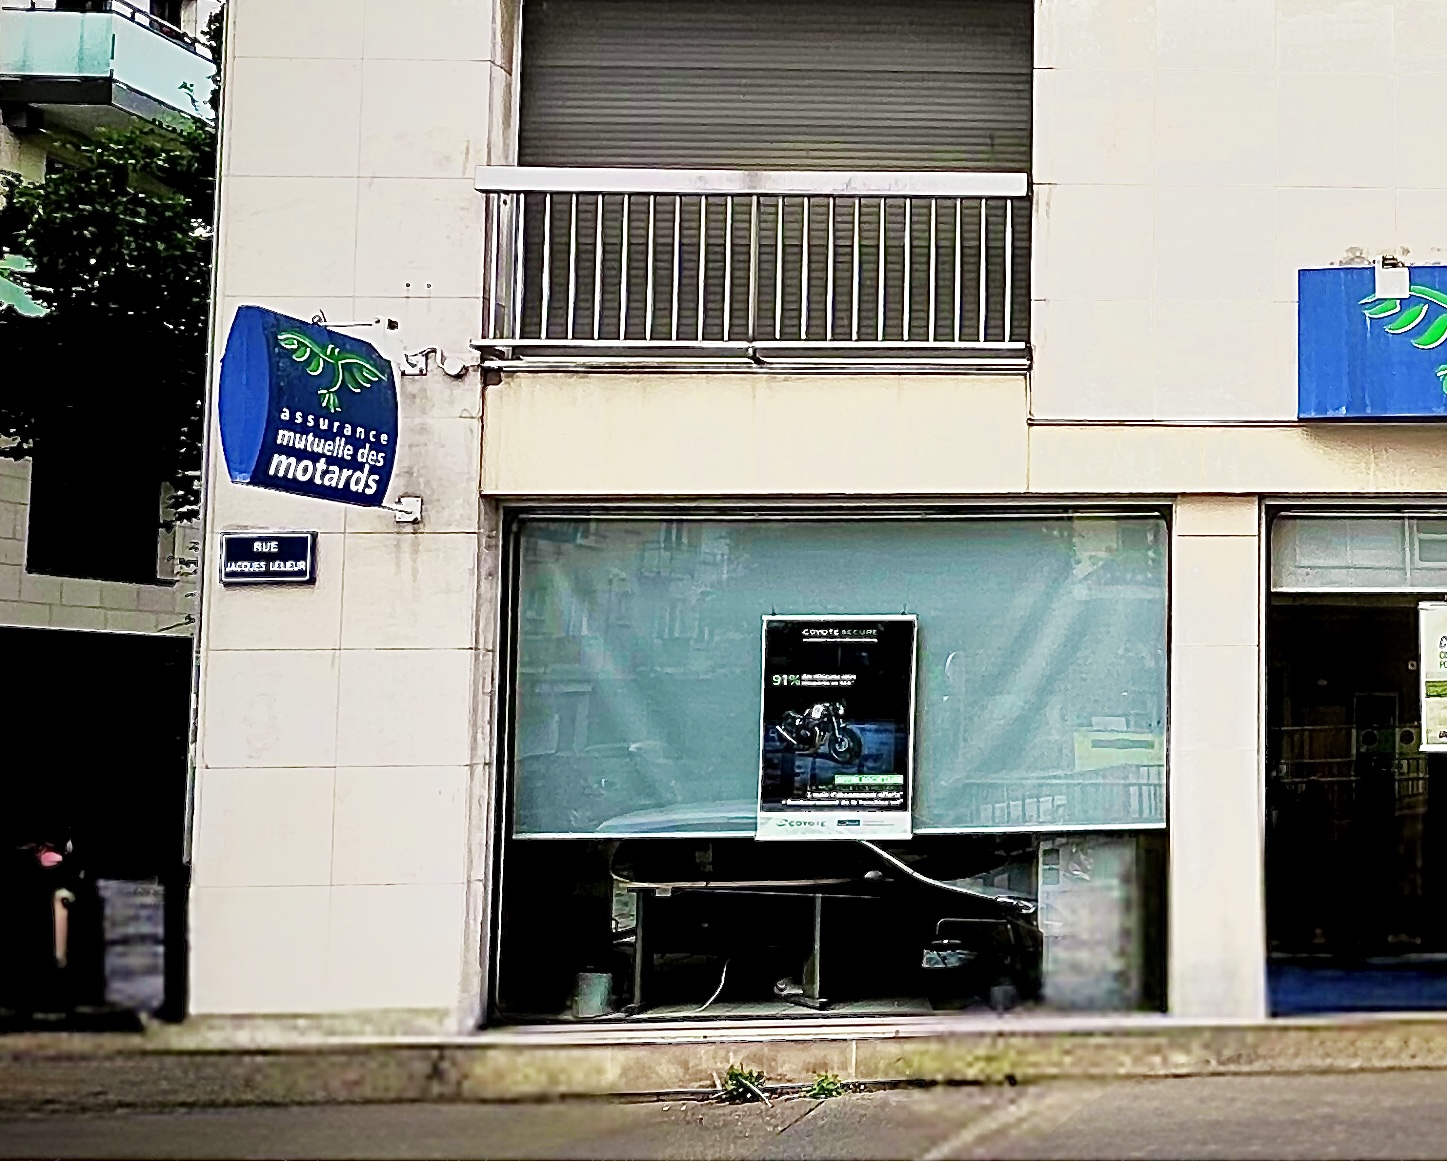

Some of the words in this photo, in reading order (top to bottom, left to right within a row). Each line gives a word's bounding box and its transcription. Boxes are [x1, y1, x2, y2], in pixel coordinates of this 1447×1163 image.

[280, 406, 389, 445] assurance
[276, 428, 354, 461] mutuelle
[357, 443, 386, 467] des
[268, 452, 380, 495] motards
[253, 541, 279, 552] RUE
[226, 561, 267, 572] JACQUES
[801, 628, 840, 636] COYOTE
[772, 674, 801, 686] 91%
